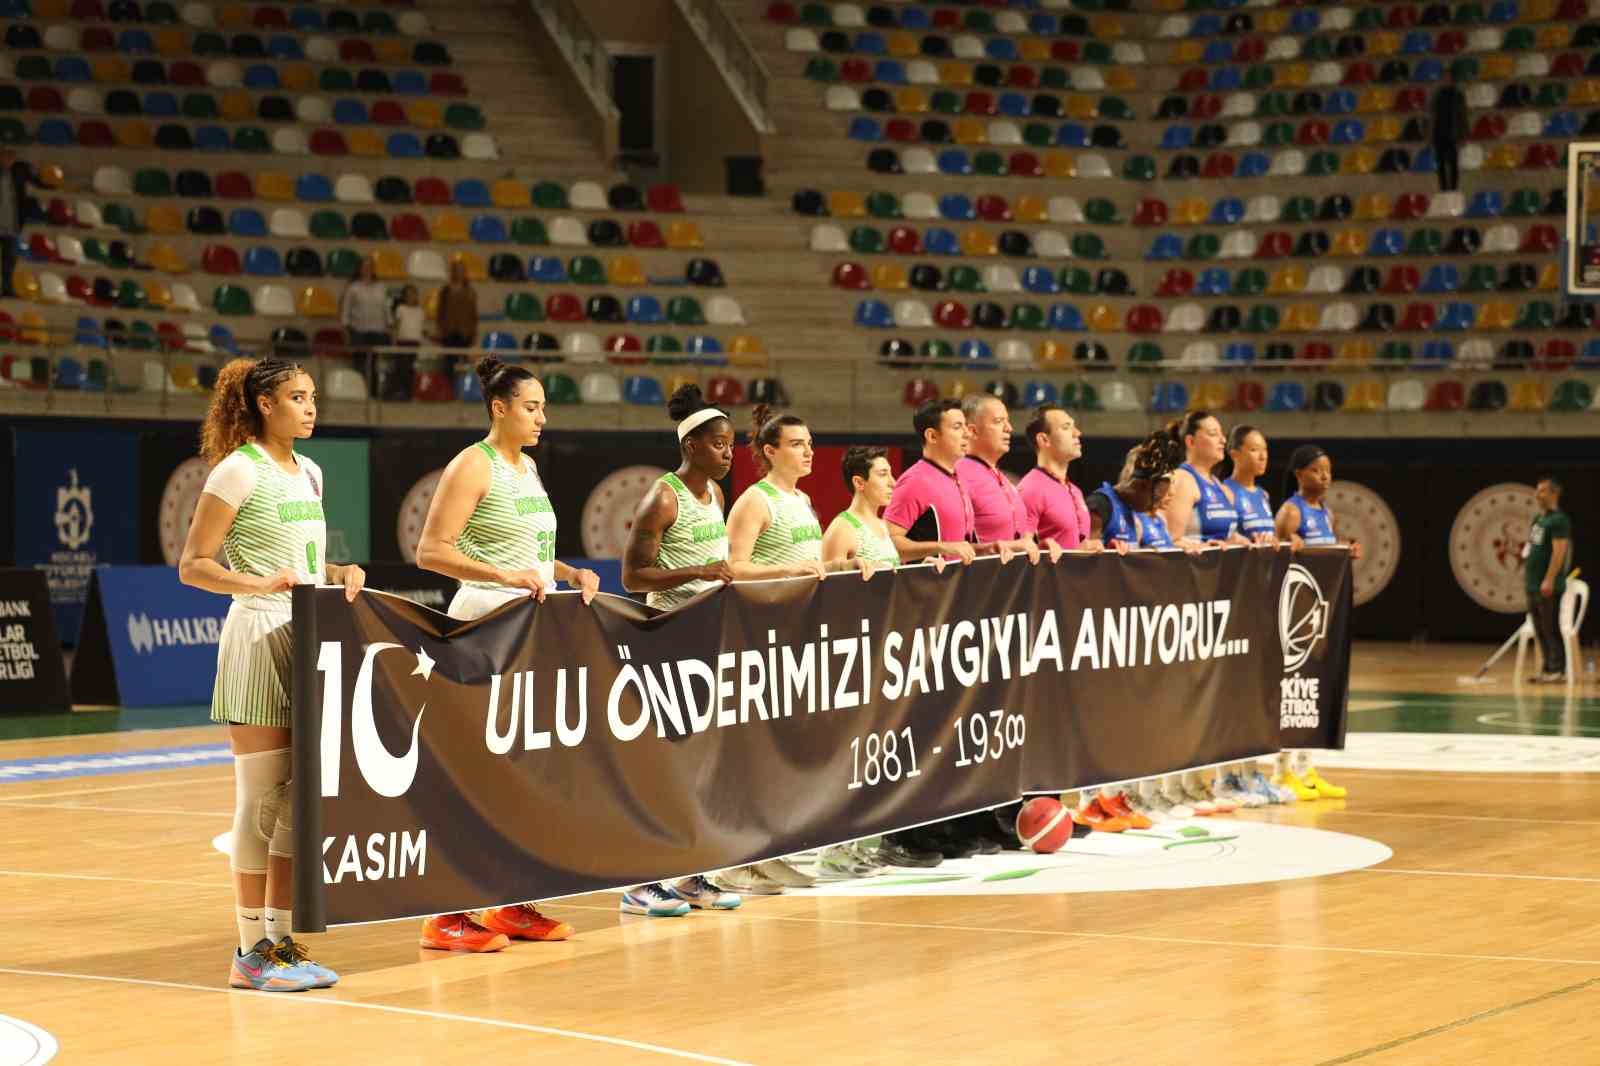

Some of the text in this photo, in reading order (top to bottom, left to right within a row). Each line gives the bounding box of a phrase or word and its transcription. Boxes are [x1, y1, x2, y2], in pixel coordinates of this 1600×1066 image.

[485, 600, 1249, 755] ULU ÖNDERİMİZİ SAYGIYLA ANIYORUZ...
[848, 726, 921, 790] 1881
